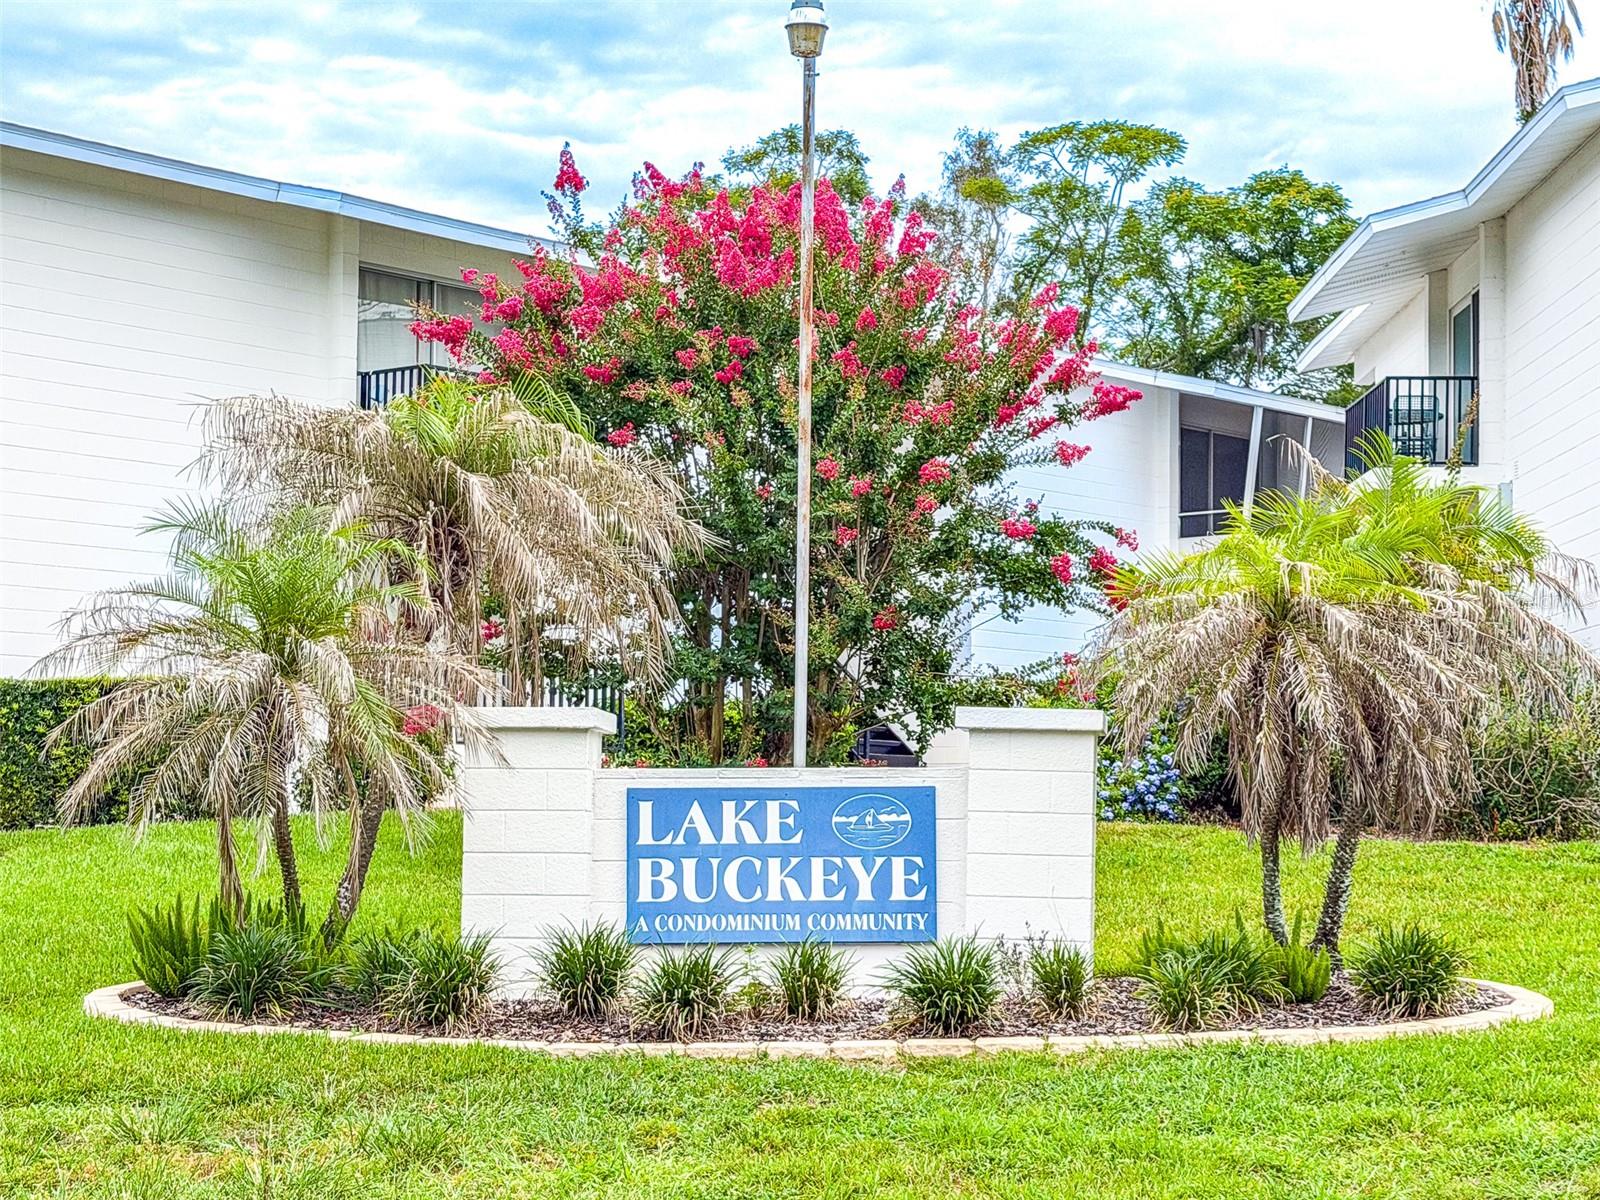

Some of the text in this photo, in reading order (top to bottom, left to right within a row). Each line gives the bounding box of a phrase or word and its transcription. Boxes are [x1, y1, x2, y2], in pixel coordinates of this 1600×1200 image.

[636, 799, 804, 846] LAKE
[636, 855, 928, 904] BUCKEYE
[634, 912, 929, 933] A CONDOMINIUM COMMUNITY
